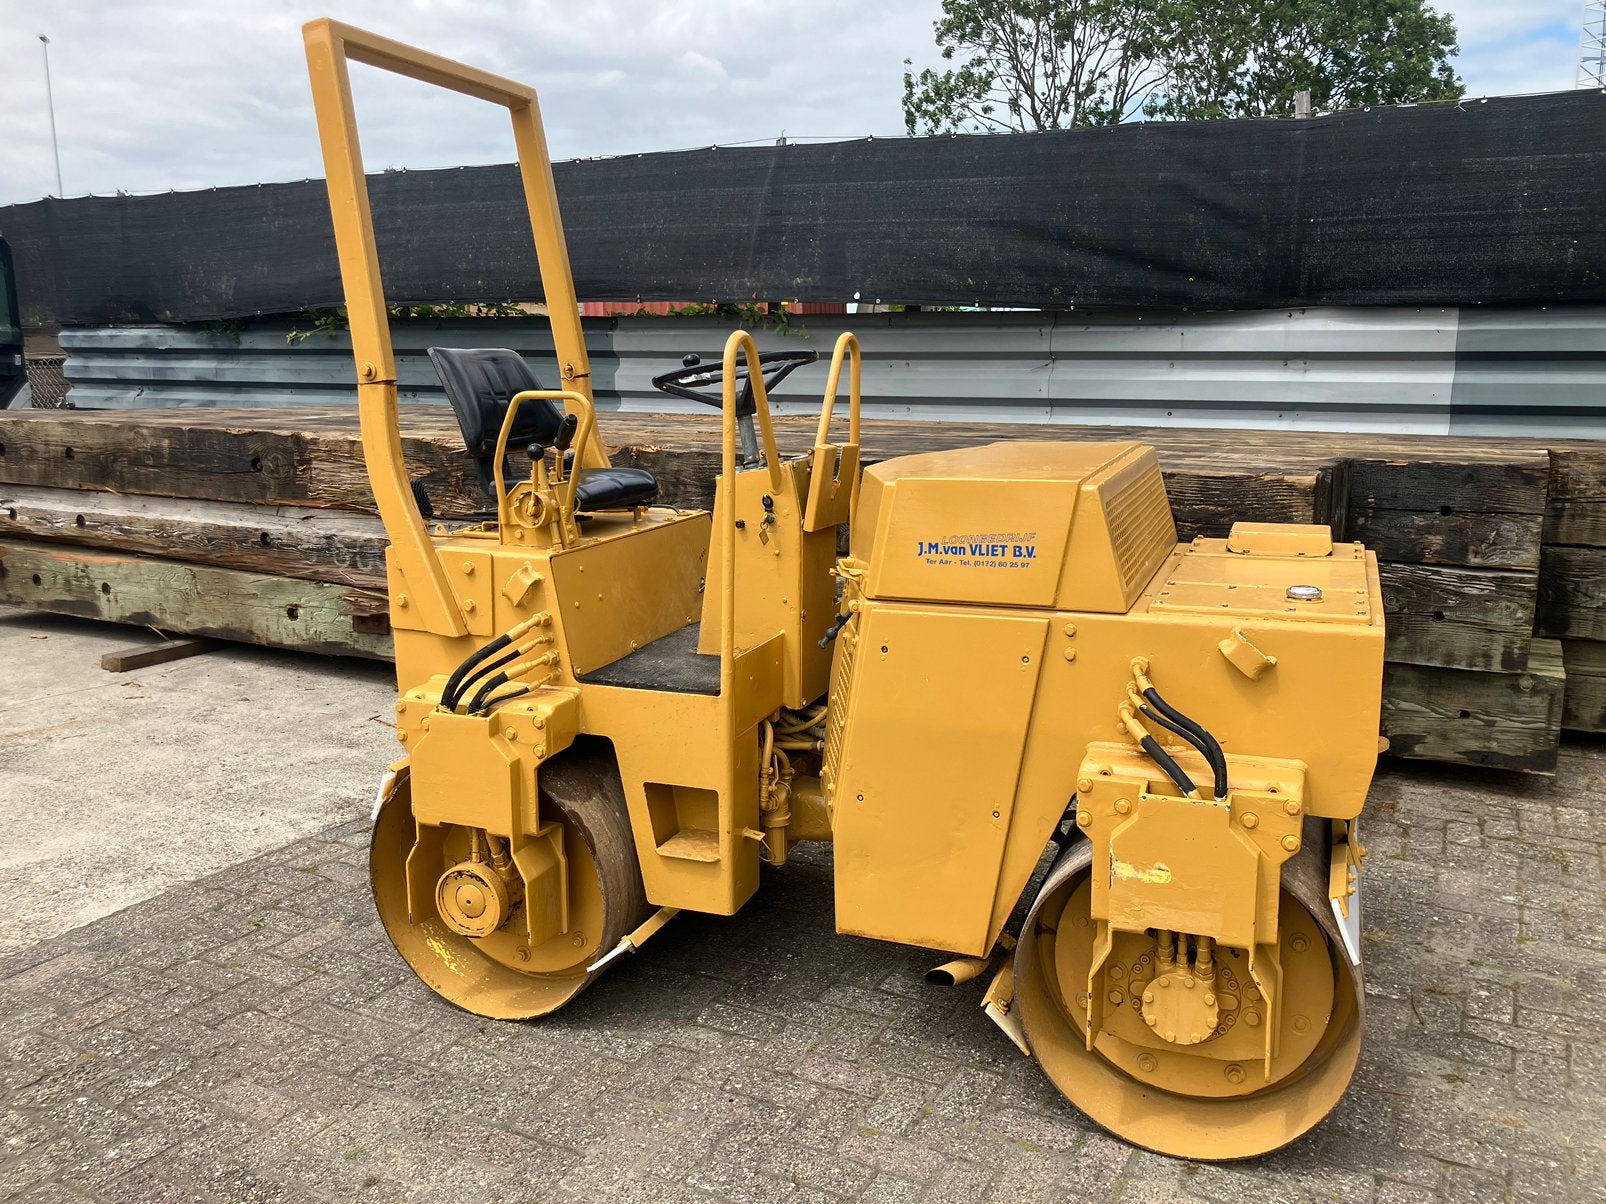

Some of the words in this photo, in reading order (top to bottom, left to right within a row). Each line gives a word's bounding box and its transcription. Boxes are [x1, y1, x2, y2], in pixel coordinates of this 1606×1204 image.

[969, 544, 1008, 557] VLIET
[1012, 545, 1037, 559] B.V.
[973, 560, 997, 568] (0172)
